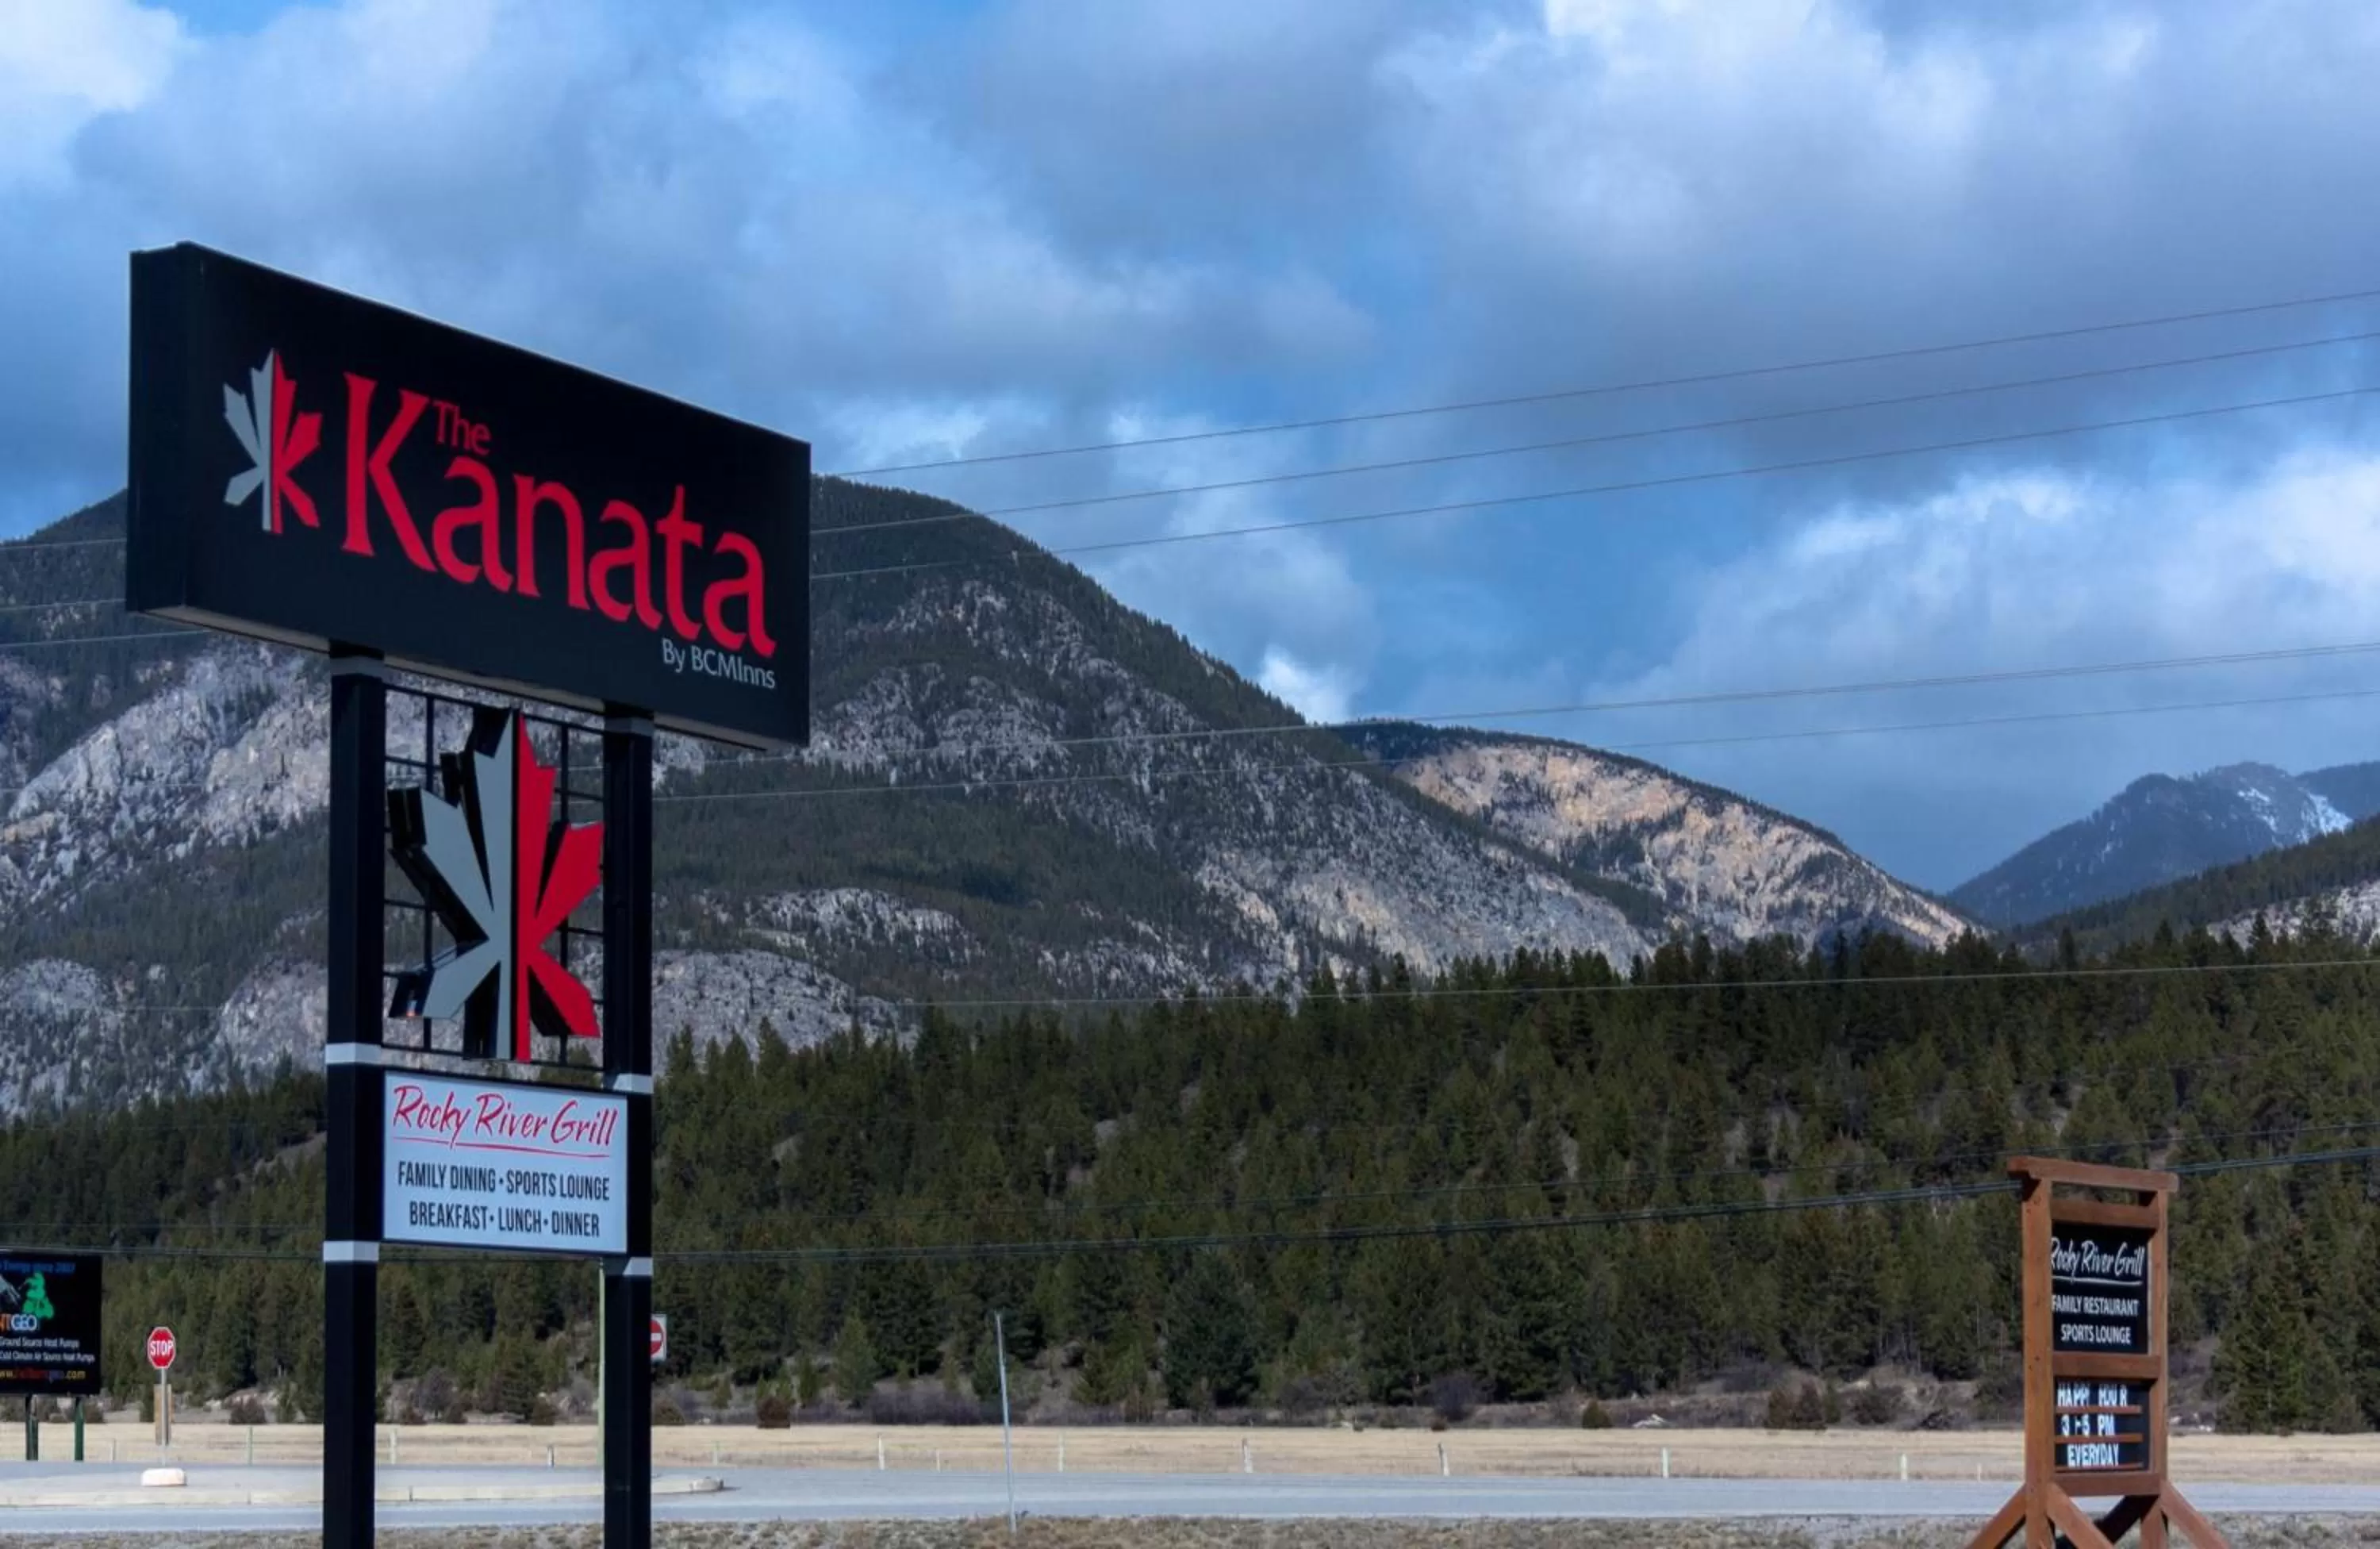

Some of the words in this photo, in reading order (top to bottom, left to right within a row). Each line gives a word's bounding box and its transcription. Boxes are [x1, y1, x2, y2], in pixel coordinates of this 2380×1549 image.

[433, 400, 490, 455] The
[342, 372, 777, 658] Kanata
[662, 637, 685, 673] By
[691, 645, 776, 689] BCMInns
[393, 1085, 470, 1149] Rocky
[475, 1093, 548, 1138] River
[551, 1099, 618, 1146] Grill
[398, 1161, 447, 1189] FAMILY
[450, 1164, 496, 1193] DINING
[506, 1169, 556, 1197] SPORTS
[559, 1174, 609, 1201] LOUNGE
[409, 1201, 488, 1230] BREAKFAST
[498, 1206, 542, 1234] LUNCH
[551, 1211, 600, 1237] DINNER
[2051, 1236, 2081, 1280] Rocky
[2081, 1240, 2114, 1273] River
[2114, 1241, 2145, 1277] Grill
[2052, 1295, 2082, 1313] FAMILY
[2083, 1297, 2140, 1317] RESTAURANT
[149, 1340, 174, 1355] STOP
[2061, 1323, 2094, 1343] SPORTS
[2095, 1325, 2132, 1345] LOUNGE
[2098, 1413, 2116, 1436] PM
[2067, 1443, 2119, 1467] EVERYDAY
